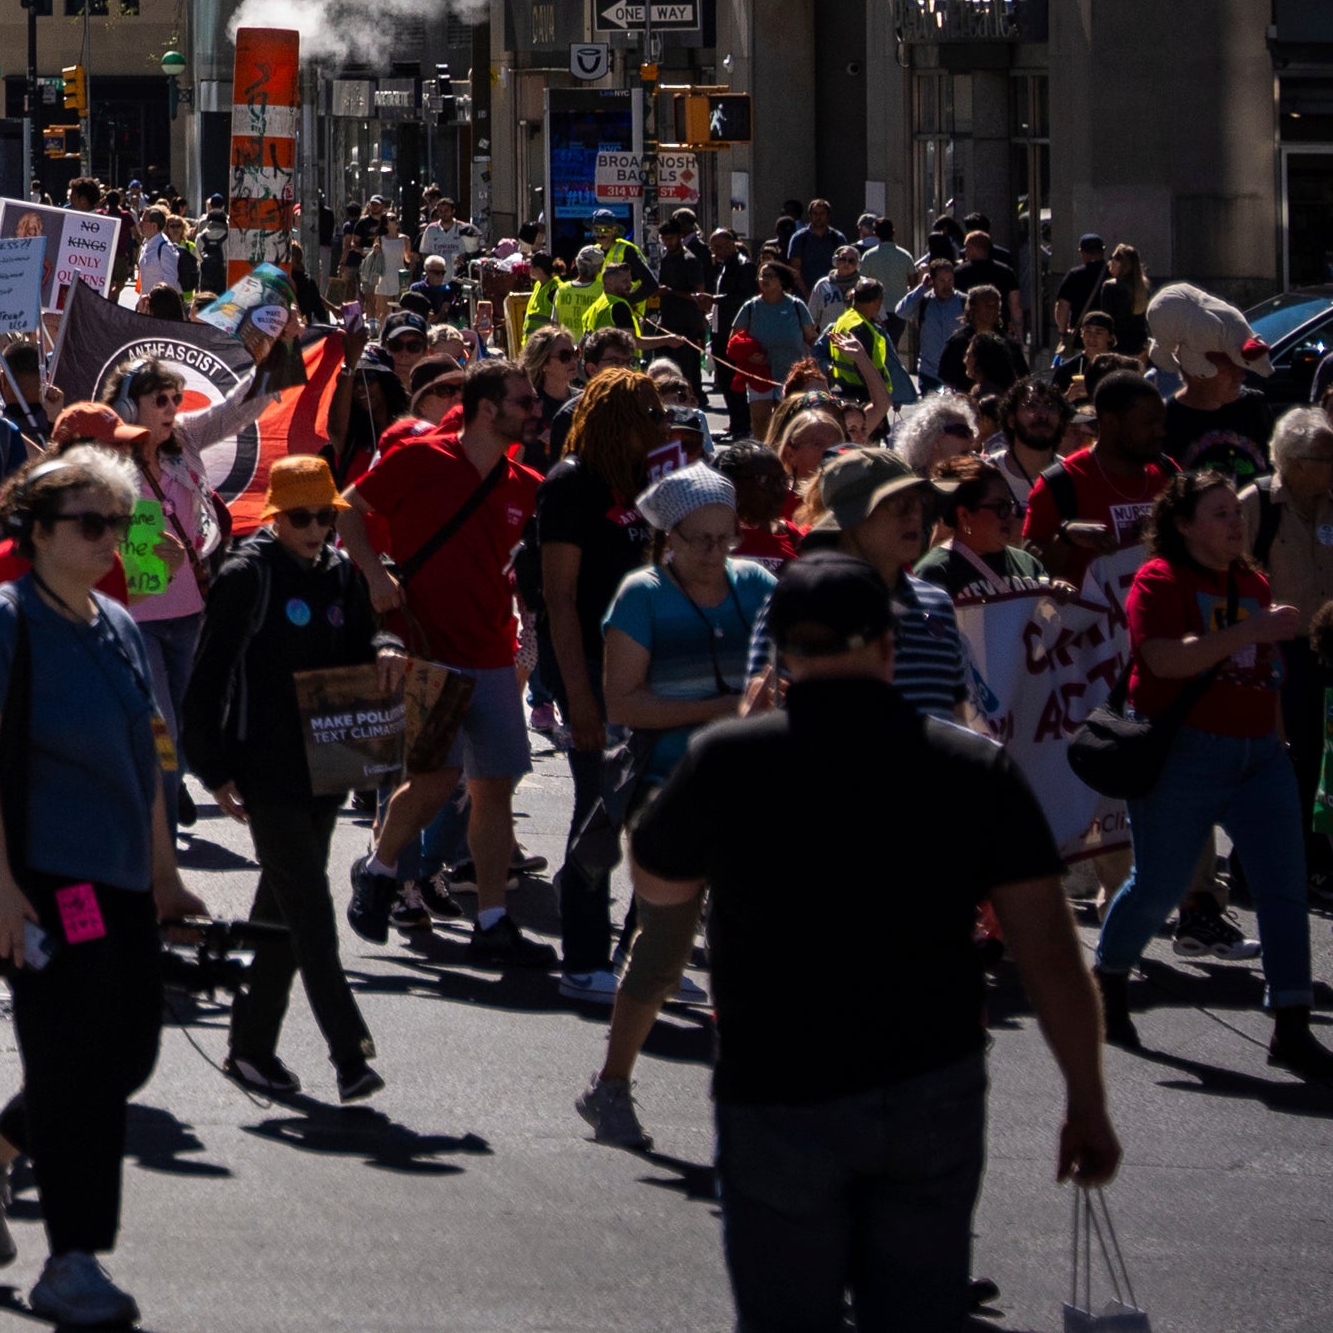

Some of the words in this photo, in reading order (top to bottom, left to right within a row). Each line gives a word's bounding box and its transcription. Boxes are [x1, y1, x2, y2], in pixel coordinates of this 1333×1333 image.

[616, 7, 643, 20] ONE
[658, 6, 687, 20] WAY
[617, 169, 677, 183] BAGLS
[608, 187, 626, 198] 314
[628, 187, 641, 197] W
[80, 221, 101, 233] NO
[68, 236, 107, 253] KINGS
[68, 254, 101, 269] ONLY
[127, 342, 222, 377] ANTIFASCIST
[310, 713, 354, 731] MAKE
[313, 730, 347, 745] TEXT
